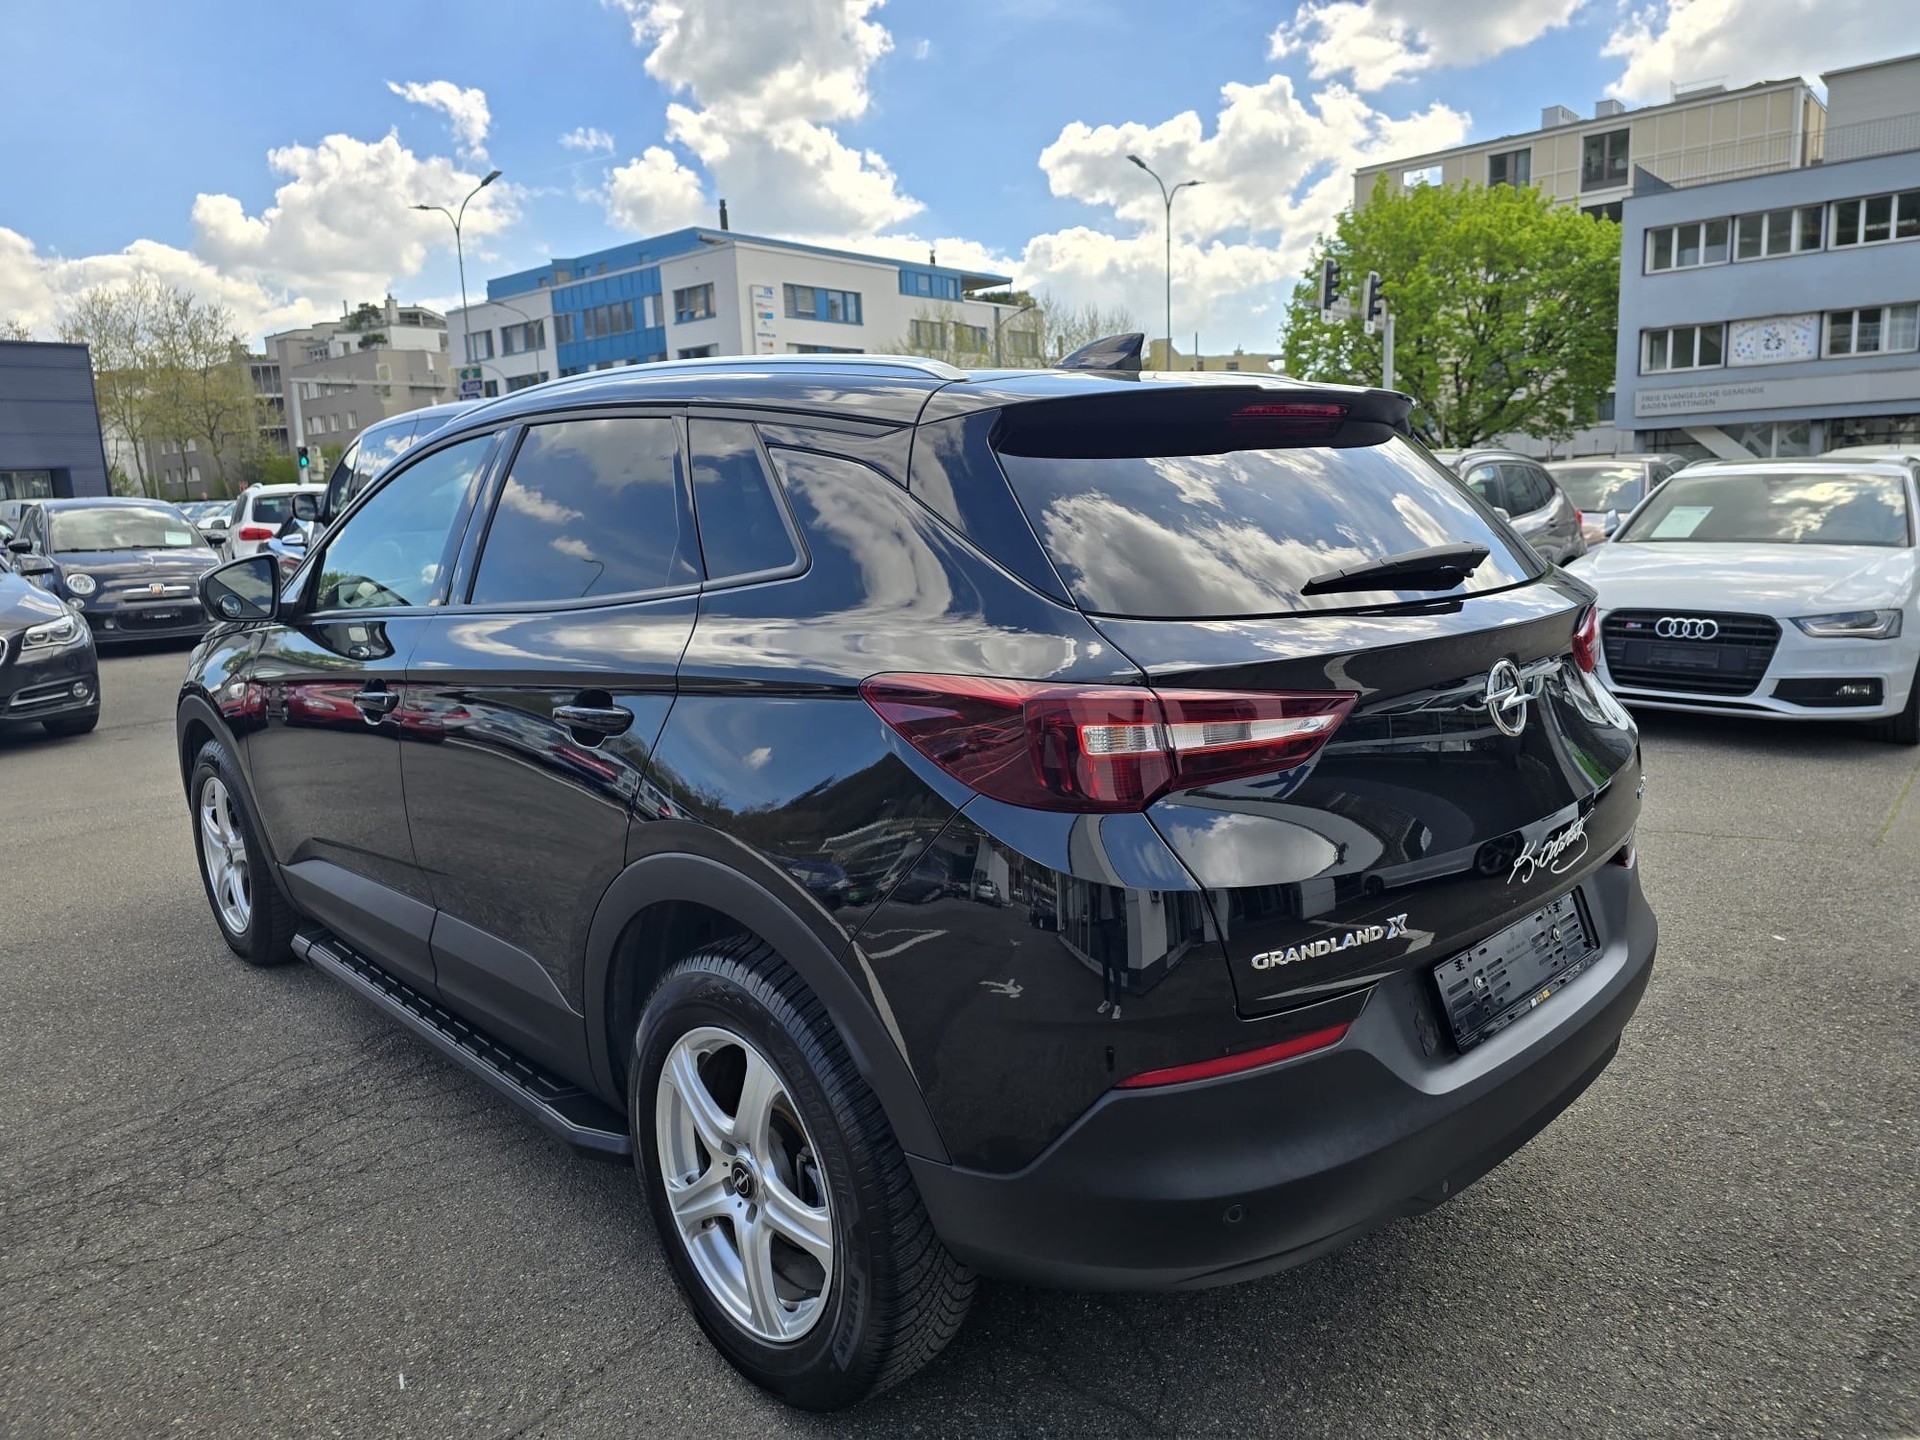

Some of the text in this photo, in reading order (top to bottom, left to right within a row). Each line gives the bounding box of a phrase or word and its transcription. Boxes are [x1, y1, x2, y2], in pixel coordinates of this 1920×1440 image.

[1641, 387, 1764, 402] FREIE EVANGELISCHE GEMEINDE
[1641, 398, 1716, 410] BADEN-WETTINGEN
[1250, 912, 1409, 971] GRANDLAND X
